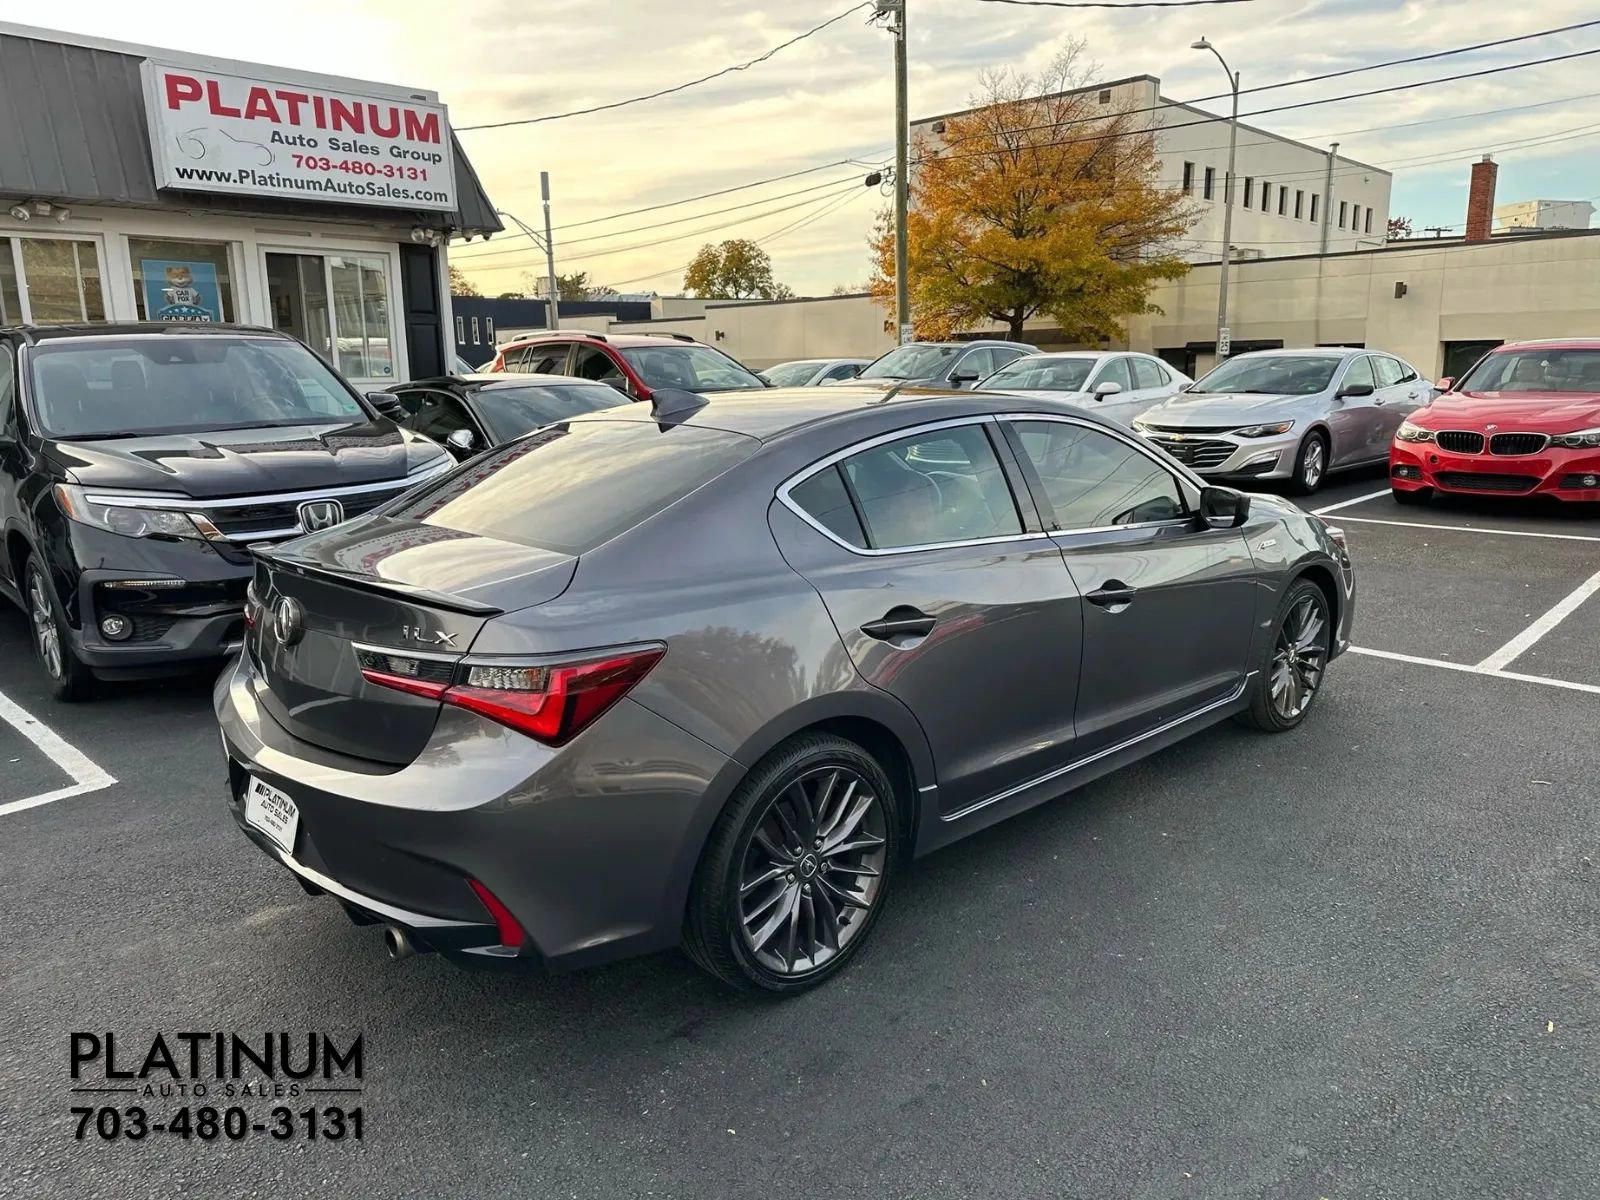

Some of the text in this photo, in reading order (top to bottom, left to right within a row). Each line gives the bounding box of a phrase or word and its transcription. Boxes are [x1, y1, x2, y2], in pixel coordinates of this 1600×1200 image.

[164, 74, 441, 144] PLATINUM
[270, 130, 442, 165] Auto Sales Group
[292, 154, 428, 182] 703-480-3131
[175, 167, 448, 203] www.PlatinumAutoSales.com
[260, 800, 275, 813] AUTO
[274, 808, 288, 824] SALES
[264, 788, 296, 817] PLATINUM
